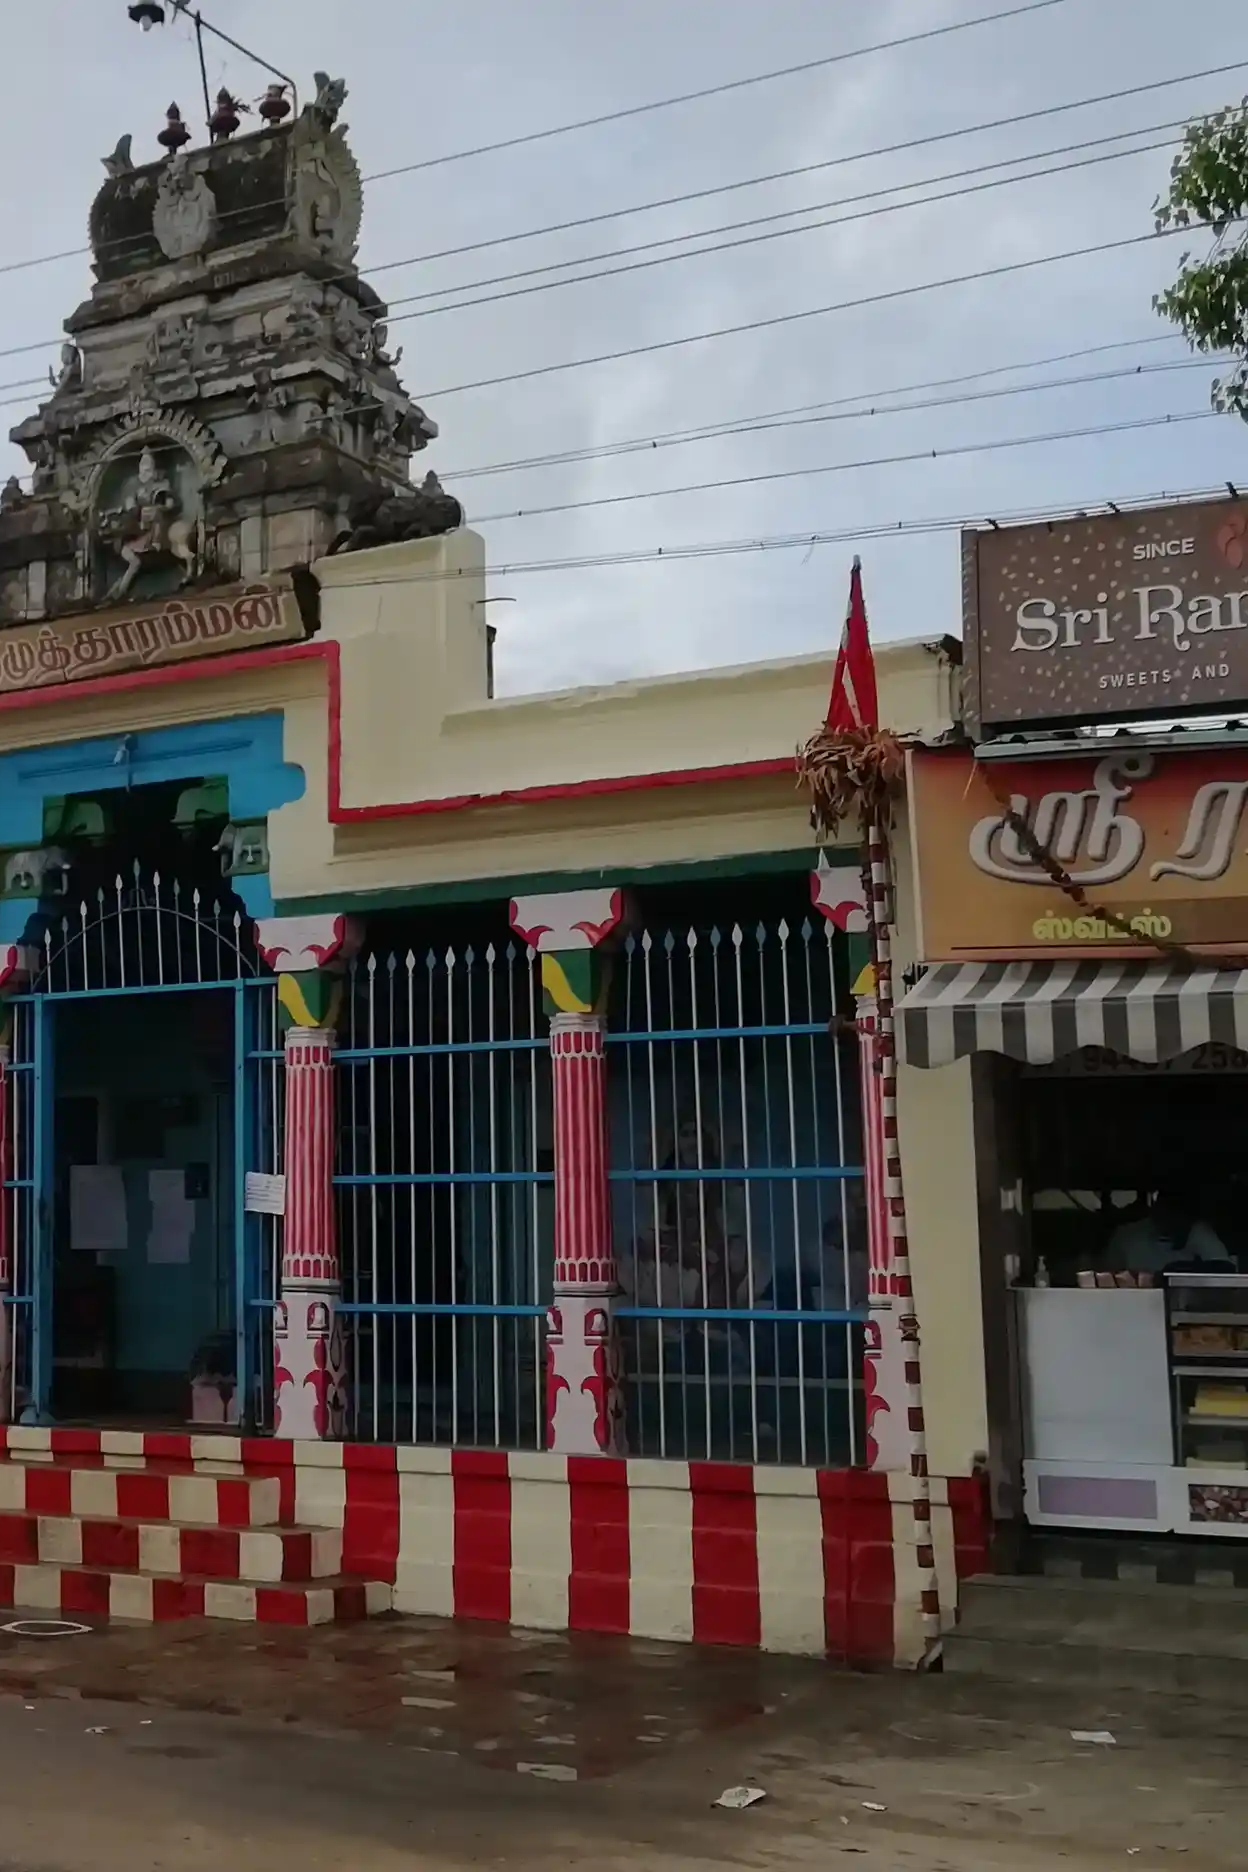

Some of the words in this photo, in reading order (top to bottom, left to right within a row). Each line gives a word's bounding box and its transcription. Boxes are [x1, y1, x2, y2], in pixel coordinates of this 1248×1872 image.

[1133, 537, 1195, 561] SINCE
[1010, 591, 1115, 652] Sri
[1099, 669, 1172, 690] SWEETS
[1192, 663, 1230, 680] AND
[1150, 781, 1248, 881] ர
[1032, 906, 1172, 940] ஸ்வட்ஸ்
